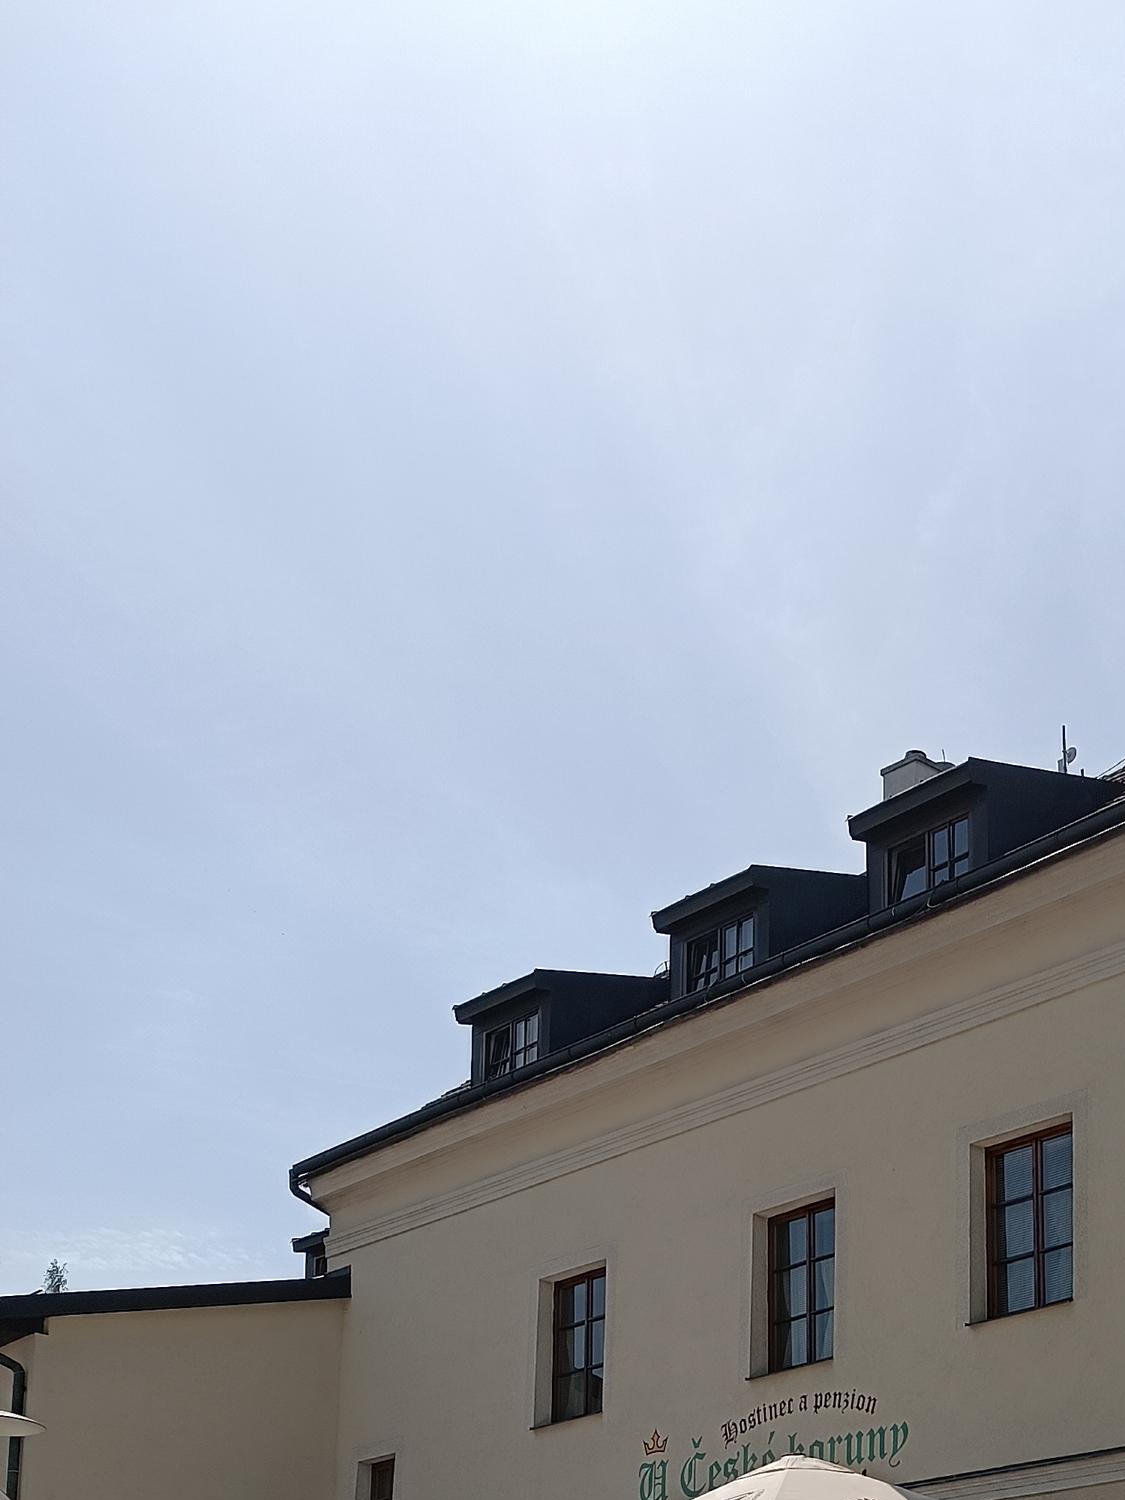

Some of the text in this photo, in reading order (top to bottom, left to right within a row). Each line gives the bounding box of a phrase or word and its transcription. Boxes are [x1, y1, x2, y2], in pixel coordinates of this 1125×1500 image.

[720, 1389, 878, 1449] Hostinec a penzion
